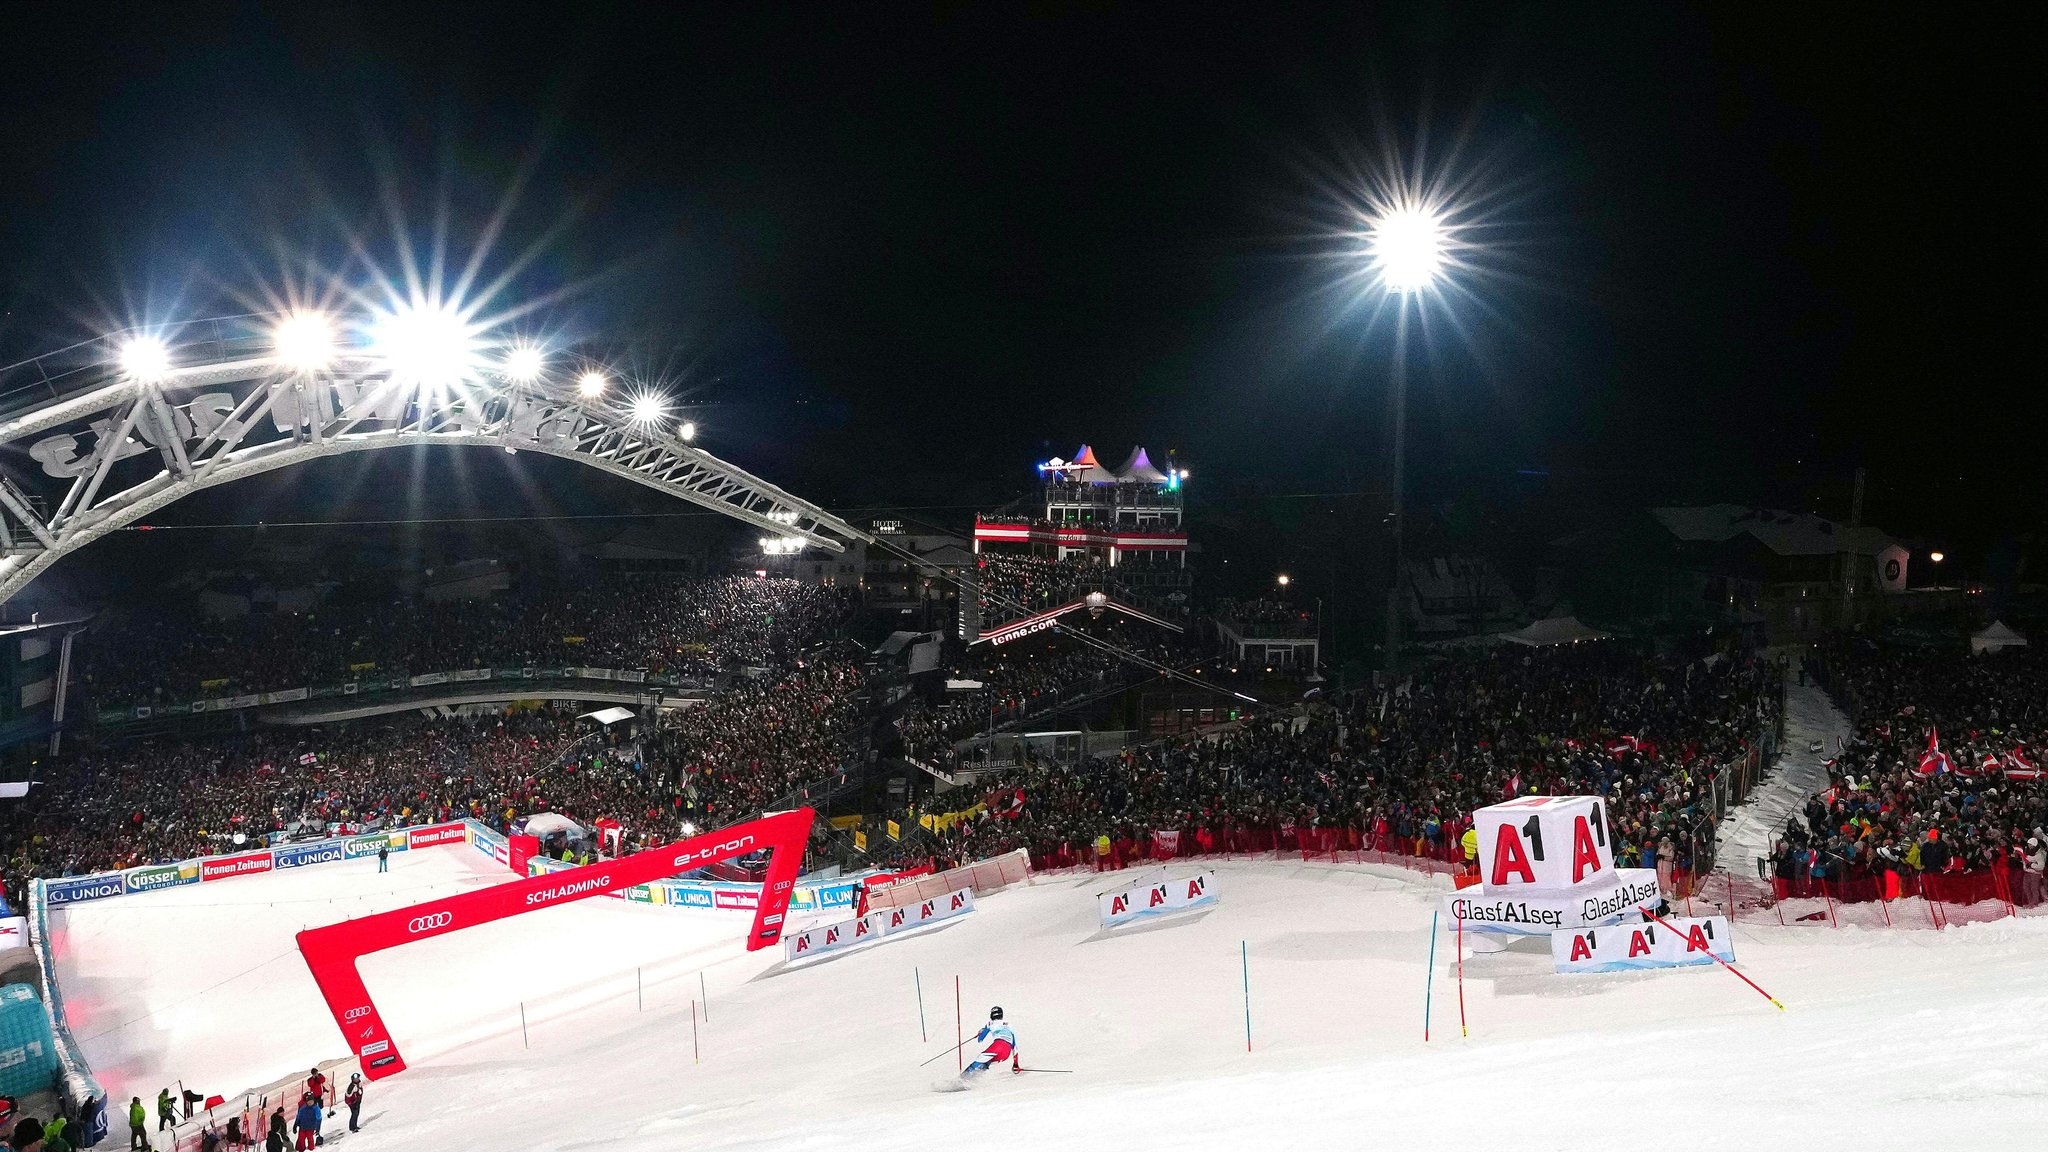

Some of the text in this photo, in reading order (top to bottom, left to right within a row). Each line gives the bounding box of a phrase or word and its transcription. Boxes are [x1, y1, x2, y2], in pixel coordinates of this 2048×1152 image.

[992, 617, 1057, 646] tenne.com
[553, 700, 576, 708] BIKE
[963, 759, 1016, 769] Restaurant
[345, 839, 388, 855] Gösser
[411, 832, 439, 844] Kronen
[1572, 801, 1606, 884] A1
[298, 850, 341, 865] UNIQA
[673, 835, 754, 867] e-tron
[1491, 815, 1545, 885] A1
[204, 857, 271, 876] Kronen Zeitung
[127, 871, 178, 890] Gösser
[526, 875, 611, 905] SCHLADMING
[1188, 876, 1205, 899] A1
[72, 884, 122, 900] UNIQA
[684, 892, 711, 905] UNIQA
[951, 891, 965, 910] A1
[1150, 884, 1167, 907] A1
[1583, 880, 1658, 921] GlasfA1ser
[921, 900, 934, 919] A1
[1111, 893, 1129, 915] A1
[1451, 899, 1562, 926] GlasfA1ser
[855, 918, 870, 937] A1
[891, 909, 905, 927] A1
[796, 934, 811, 952] A1
[826, 926, 839, 944] A1
[1629, 925, 1656, 958] A1
[1687, 920, 1714, 952] A1
[1570, 930, 1597, 962] A1
